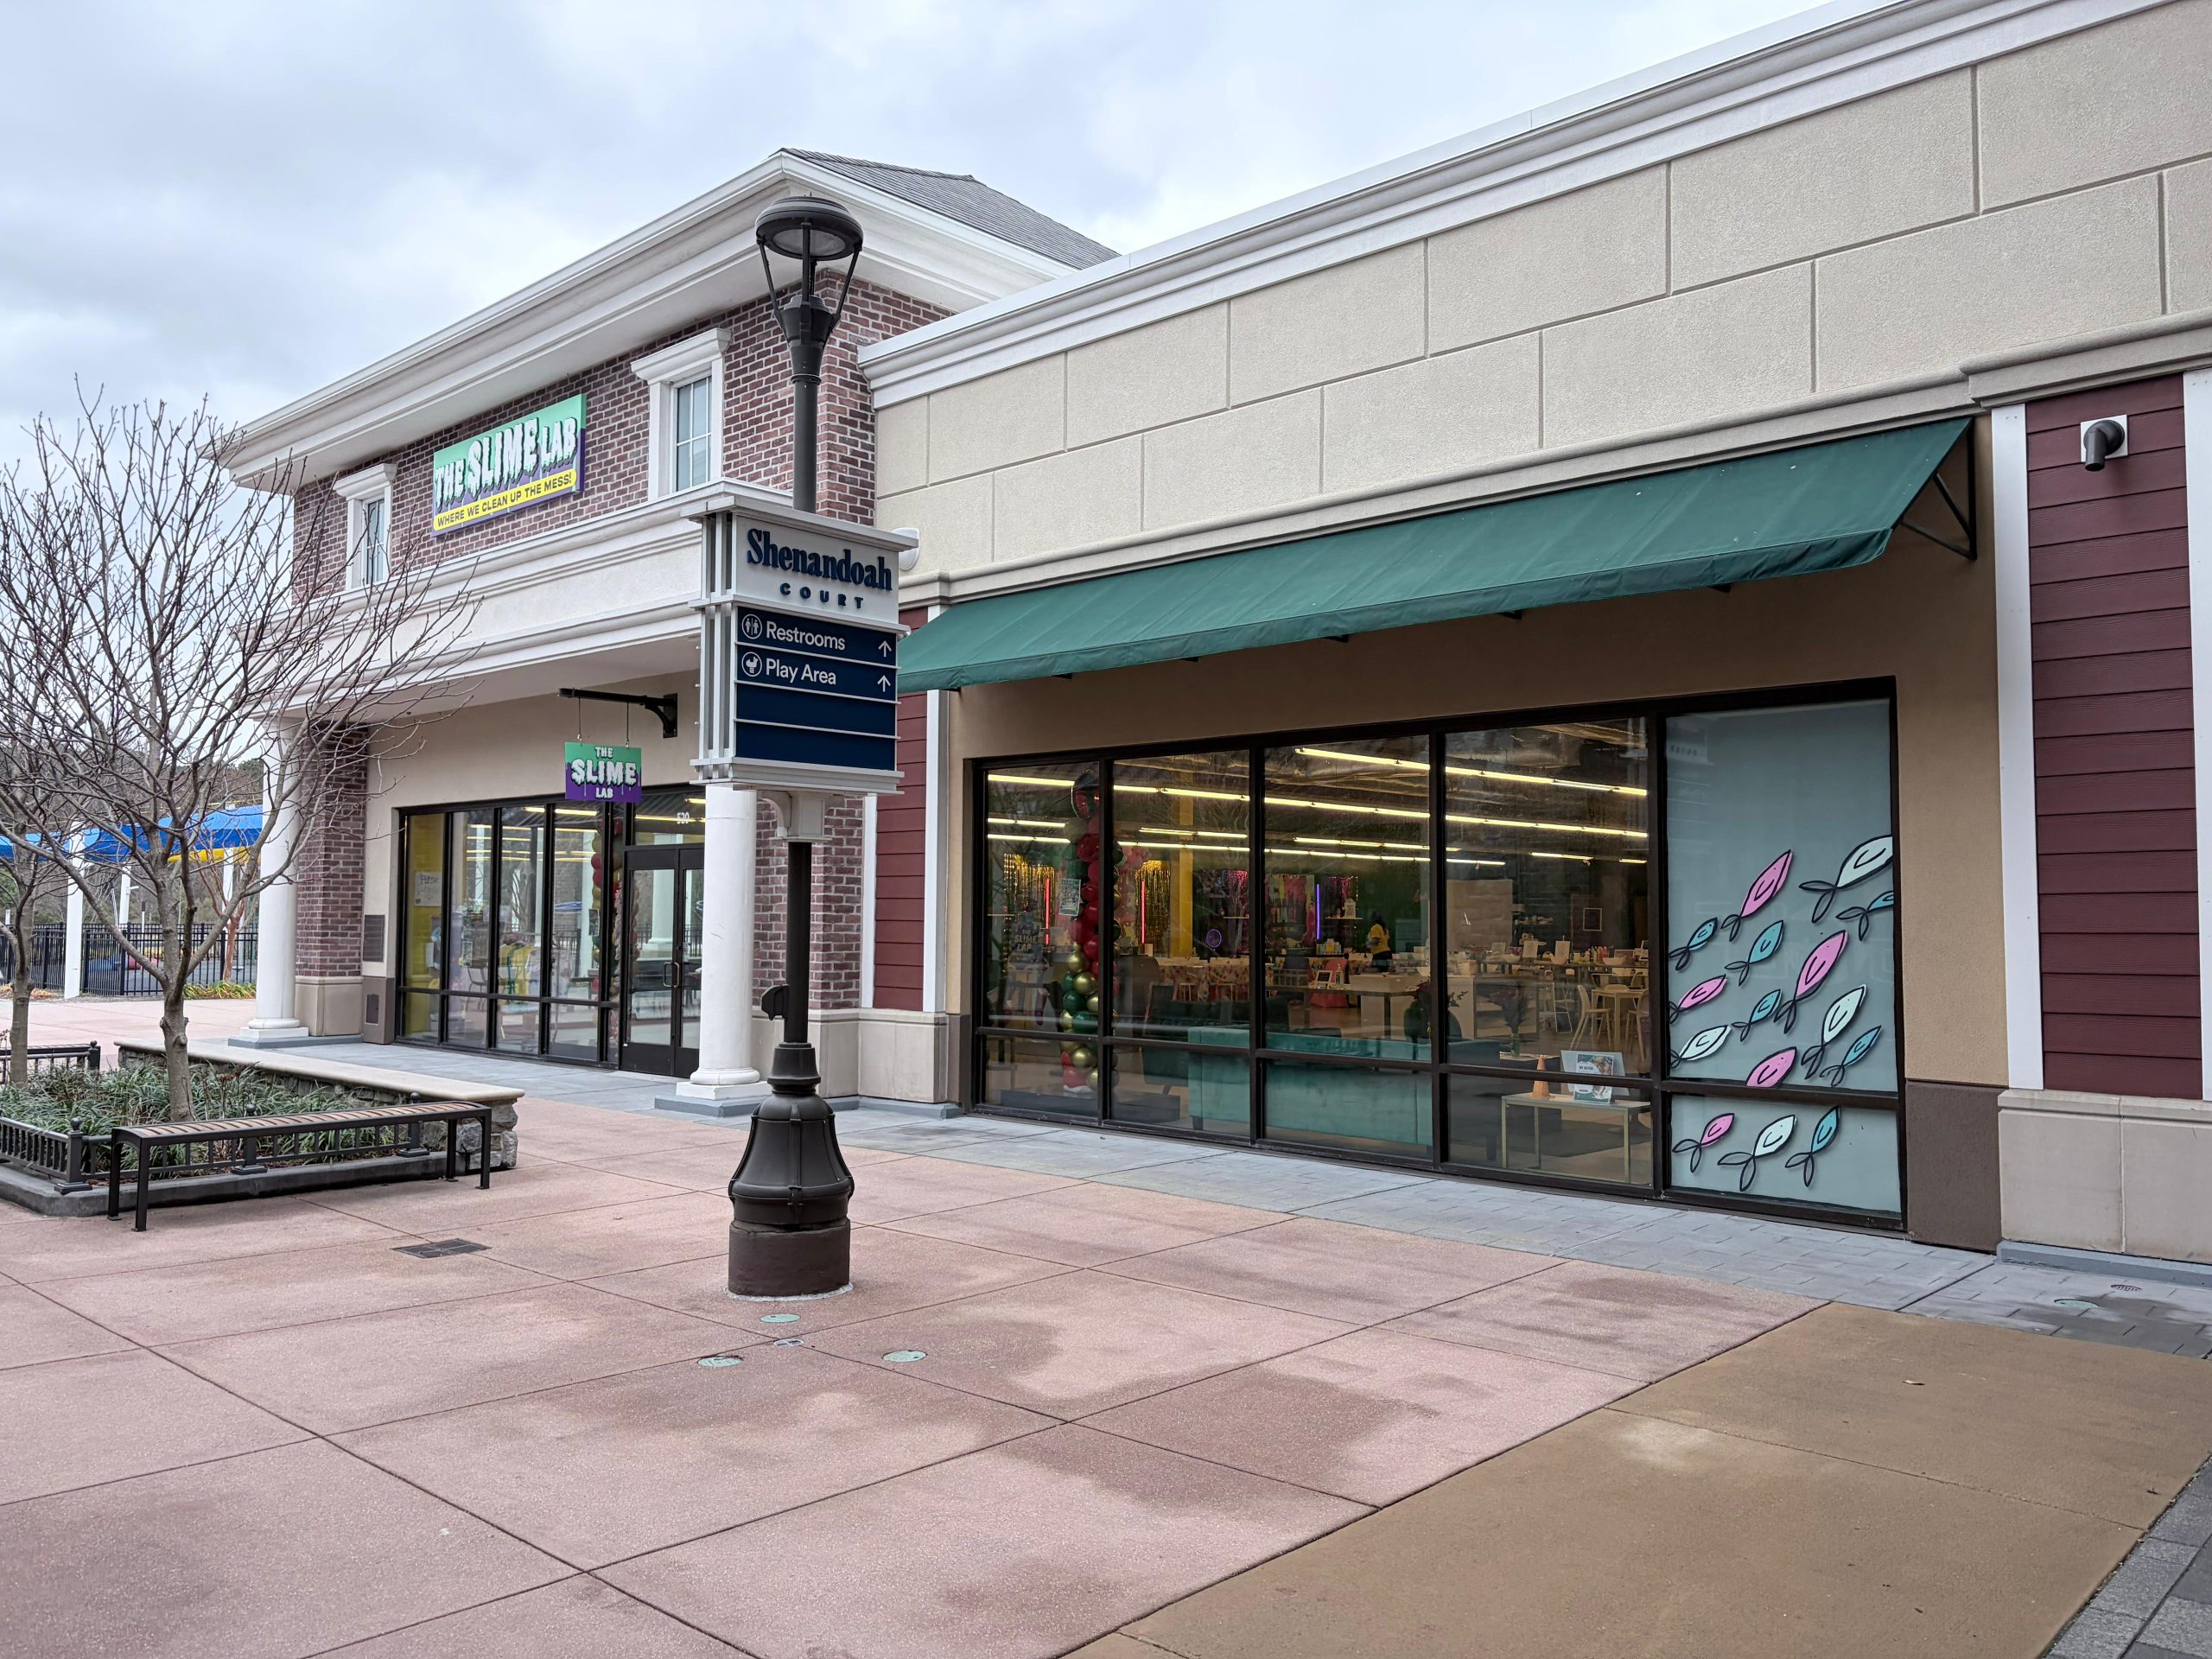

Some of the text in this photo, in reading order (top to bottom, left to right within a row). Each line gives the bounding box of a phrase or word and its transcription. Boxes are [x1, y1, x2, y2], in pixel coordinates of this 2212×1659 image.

[434, 417, 577, 512] THE SLIME LAB
[437, 473, 572, 527] WHERE WE CLEAN UP THE MESS!
[747, 528, 893, 591] Shenandoah
[779, 582, 864, 609] COURT
[766, 620, 846, 651] Restrooms
[766, 658, 836, 685] Play Area
[594, 747, 613, 759] THE
[571, 759, 637, 786] SLIME
[595, 787, 613, 799] LAB
[677, 811, 690, 824] 520
